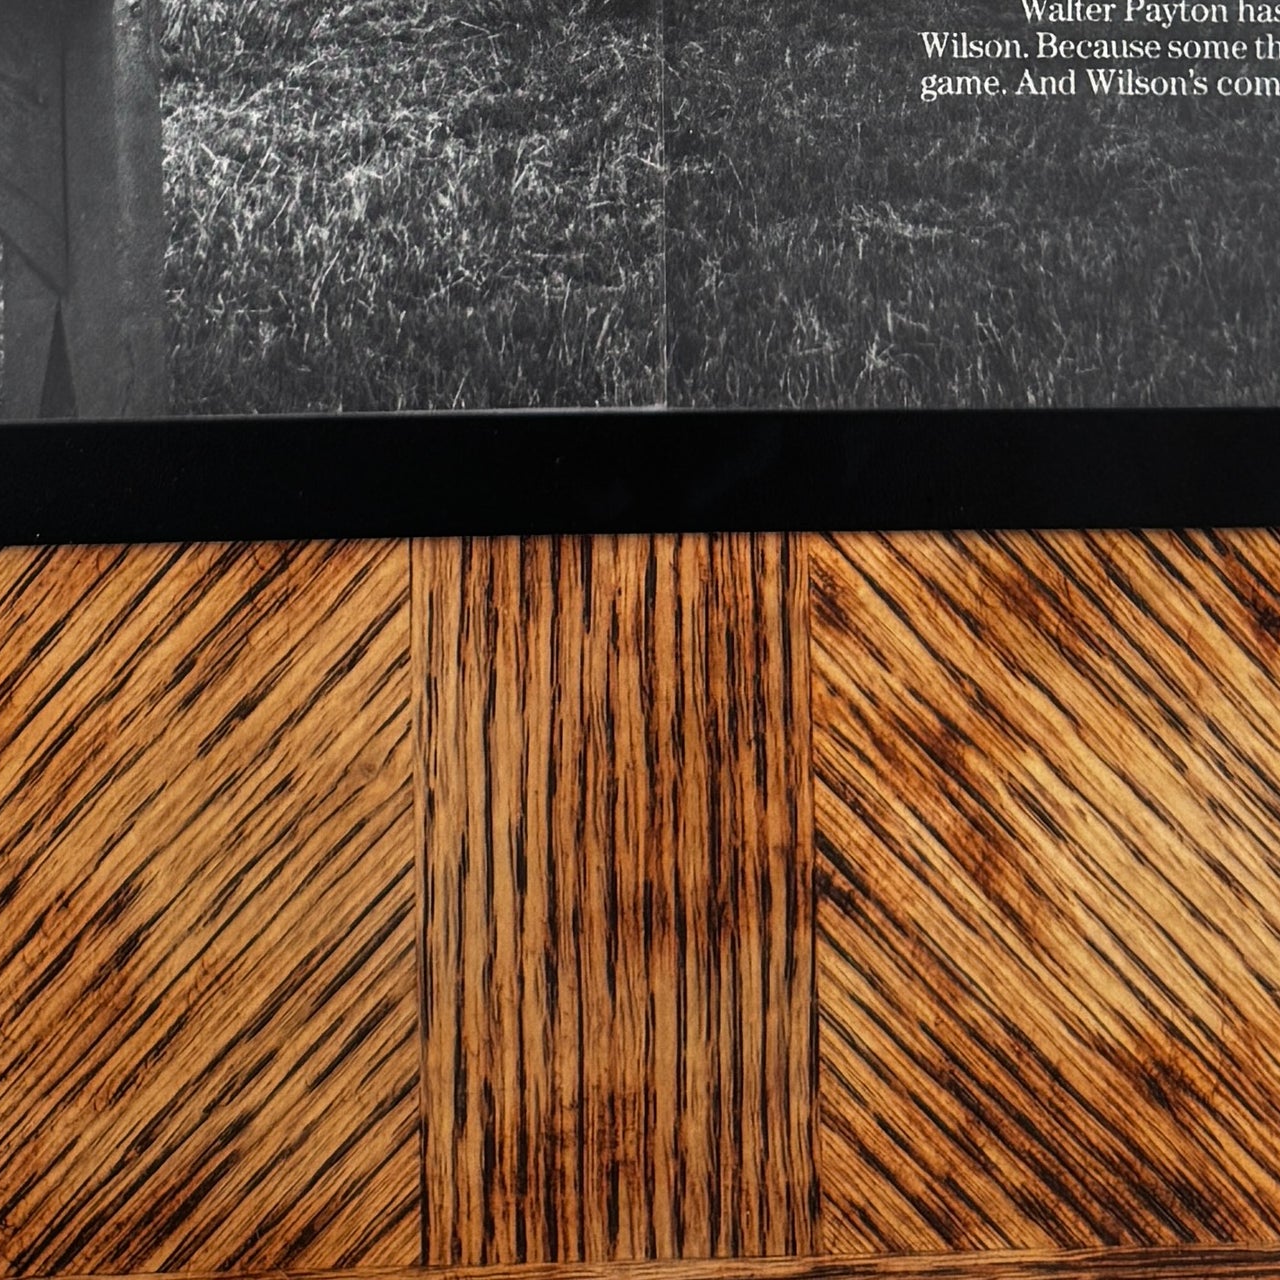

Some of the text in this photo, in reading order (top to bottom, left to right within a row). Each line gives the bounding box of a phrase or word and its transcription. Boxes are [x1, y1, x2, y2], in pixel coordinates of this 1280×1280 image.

[918, 32, 1028, 58] Wilson.
[1036, 32, 1161, 59] Because
[1168, 40, 1247, 59] some
[921, 74, 1006, 102] game.
[1015, 69, 1075, 96] And
[1086, 69, 1208, 96] Wilson's
